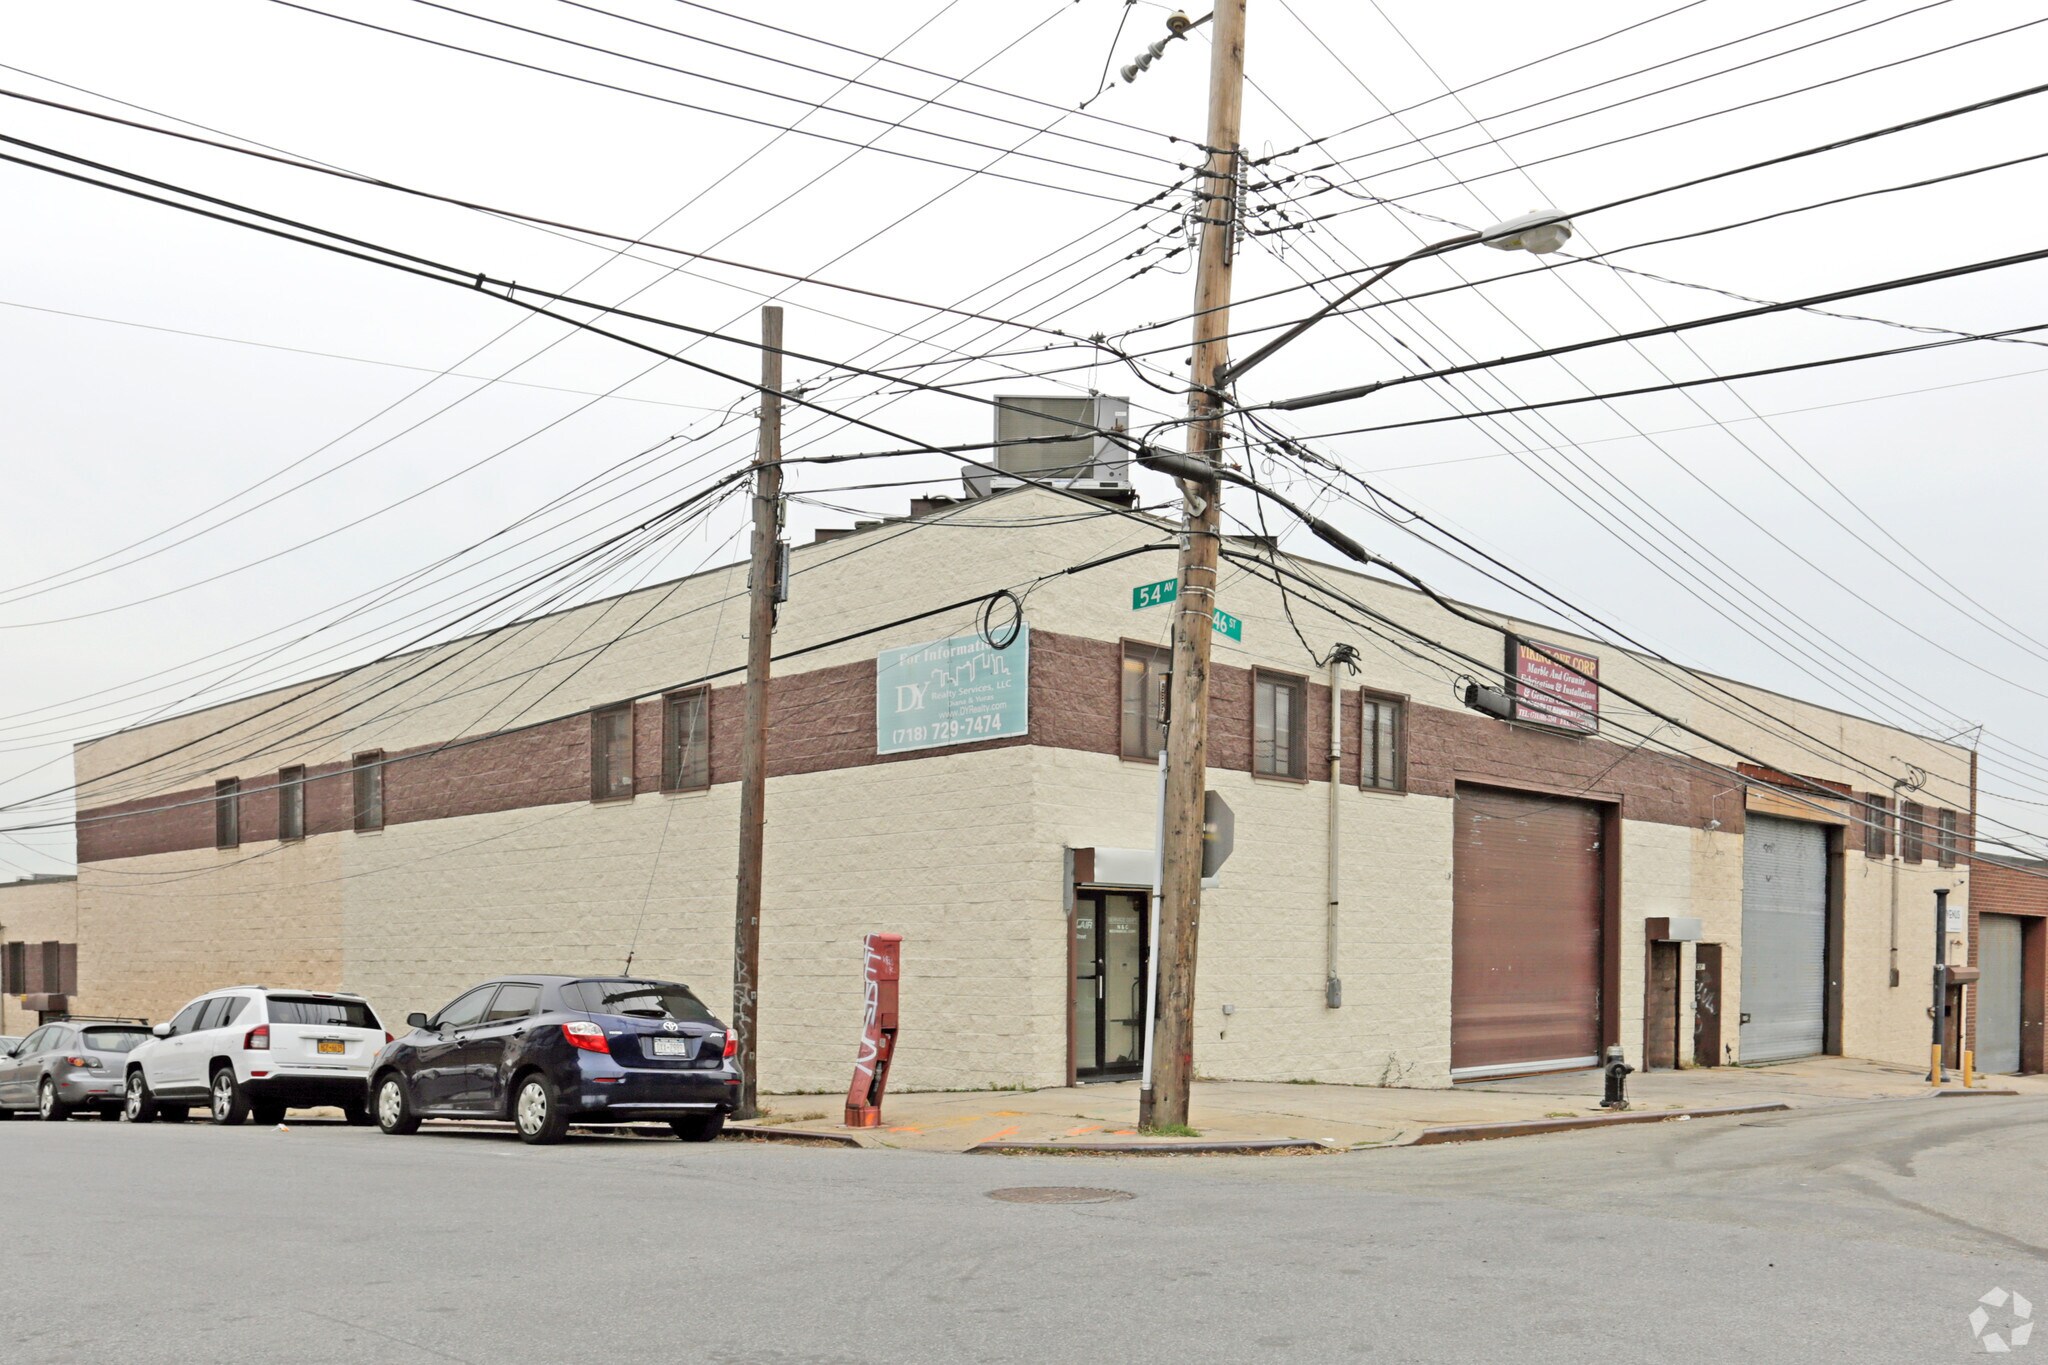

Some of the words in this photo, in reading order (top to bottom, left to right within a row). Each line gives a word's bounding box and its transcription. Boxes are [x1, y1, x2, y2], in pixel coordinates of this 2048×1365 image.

[1140, 584, 1161, 607] 54
[1164, 581, 1174, 592] AV
[1212, 611, 1228, 633] 46
[1229, 618, 1237, 629] ST
[899, 653, 919, 666] For
[1572, 657, 1596, 675] CORP
[1527, 662, 1549, 676] Marble
[1549, 669, 1563, 680] And
[1563, 672, 1587, 686] Granite
[895, 680, 931, 714] DY
[931, 690, 957, 700] Realty
[996, 679, 1012, 689] LLC
[1562, 682, 1596, 700] Installation
[892, 726, 928, 744] (718)
[931, 713, 1002, 740] 729-7474
